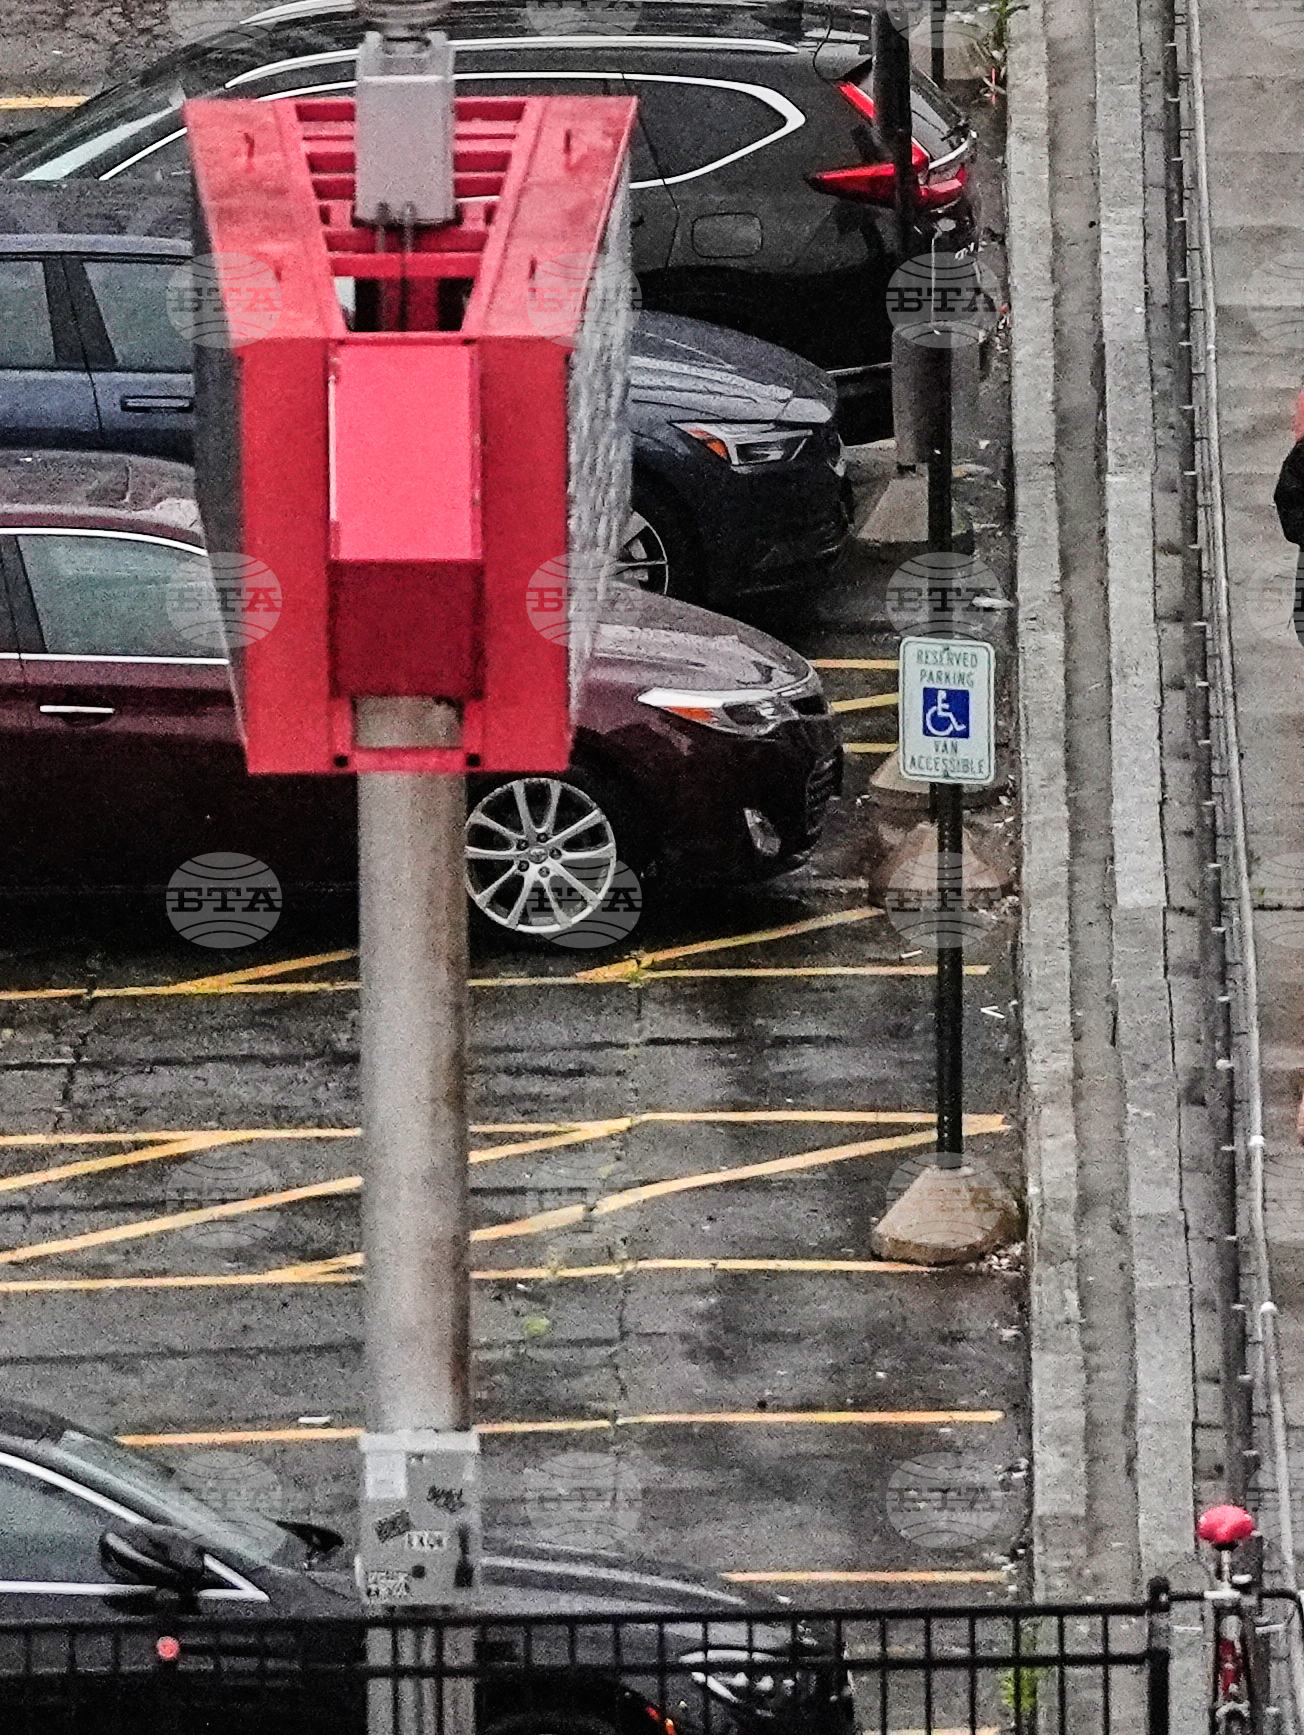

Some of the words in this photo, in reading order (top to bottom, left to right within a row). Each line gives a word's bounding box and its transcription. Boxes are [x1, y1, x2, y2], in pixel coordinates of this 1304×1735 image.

[916, 648, 979, 668] RESERVED
[919, 669, 975, 688] PARKING
[933, 740, 958, 754] VAN
[909, 754, 985, 775] ACCESSIBLE
